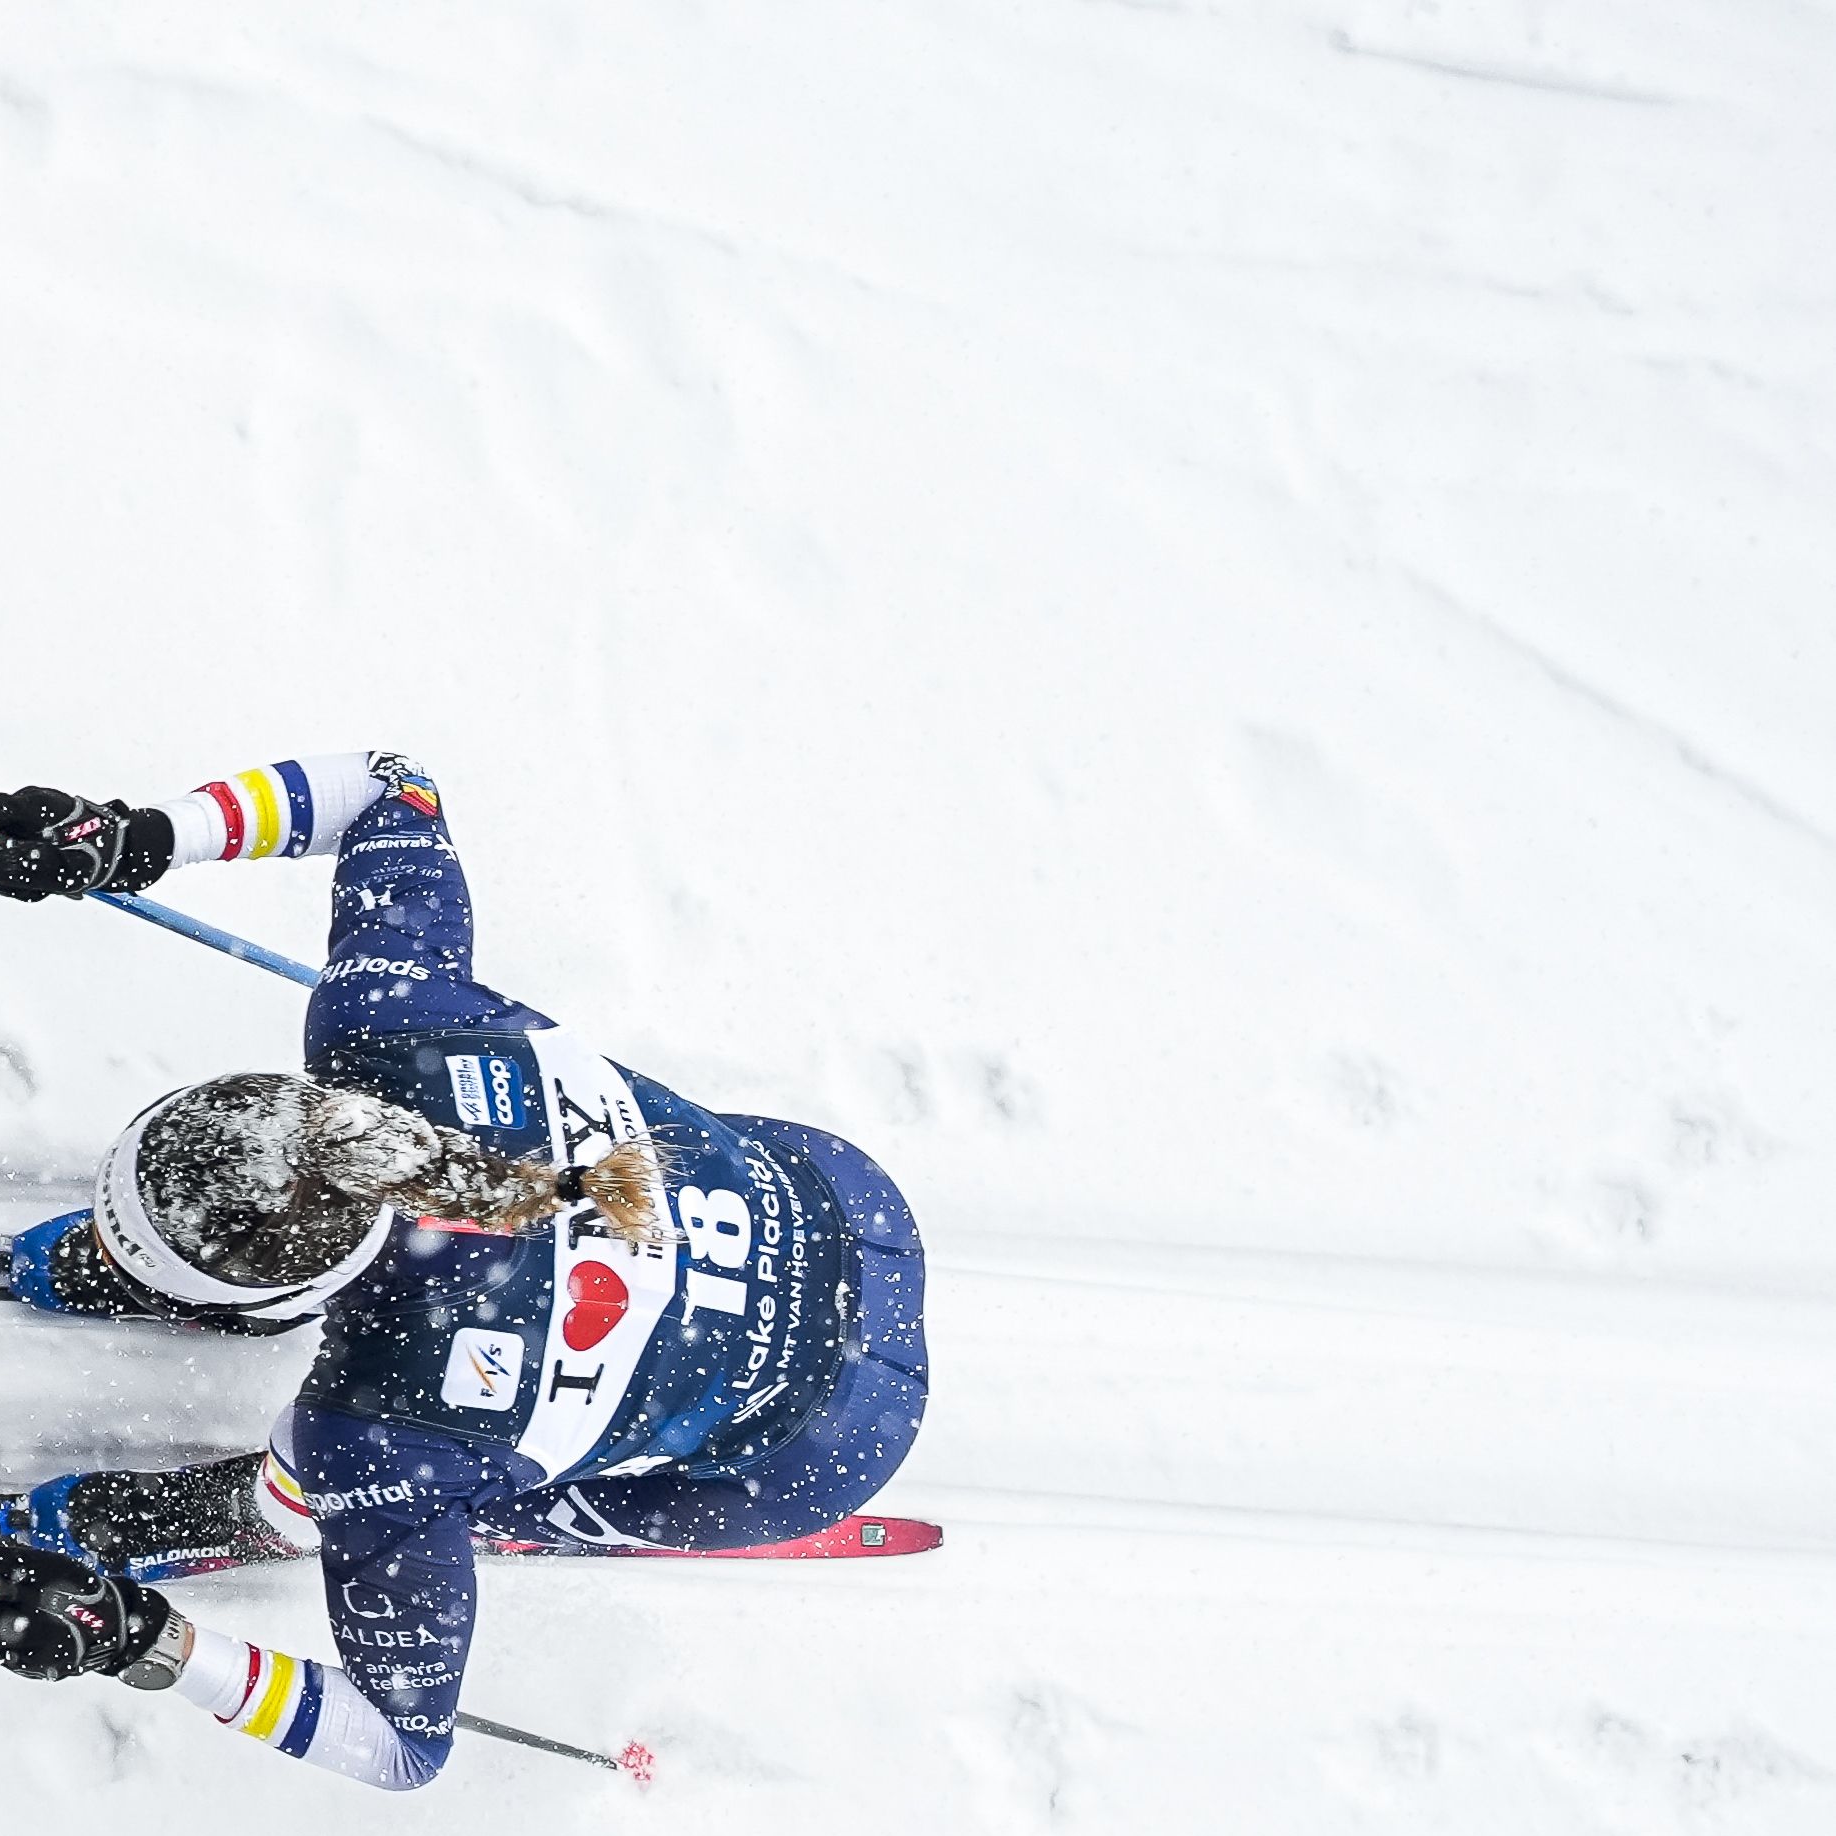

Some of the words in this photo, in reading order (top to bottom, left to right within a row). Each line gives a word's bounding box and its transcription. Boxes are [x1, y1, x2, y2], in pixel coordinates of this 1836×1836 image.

[489, 1059, 513, 1125] coop
[744, 1156, 780, 1283] Placid
[677, 1185, 752, 1326] 18
[786, 1282, 804, 1333] VAN
[732, 1295, 777, 1390] Lake
[777, 1332, 798, 1369] MT
[480, 1344, 501, 1398] FIS
[548, 1361, 605, 1406] I
[129, 1544, 231, 1572] SALOMON
